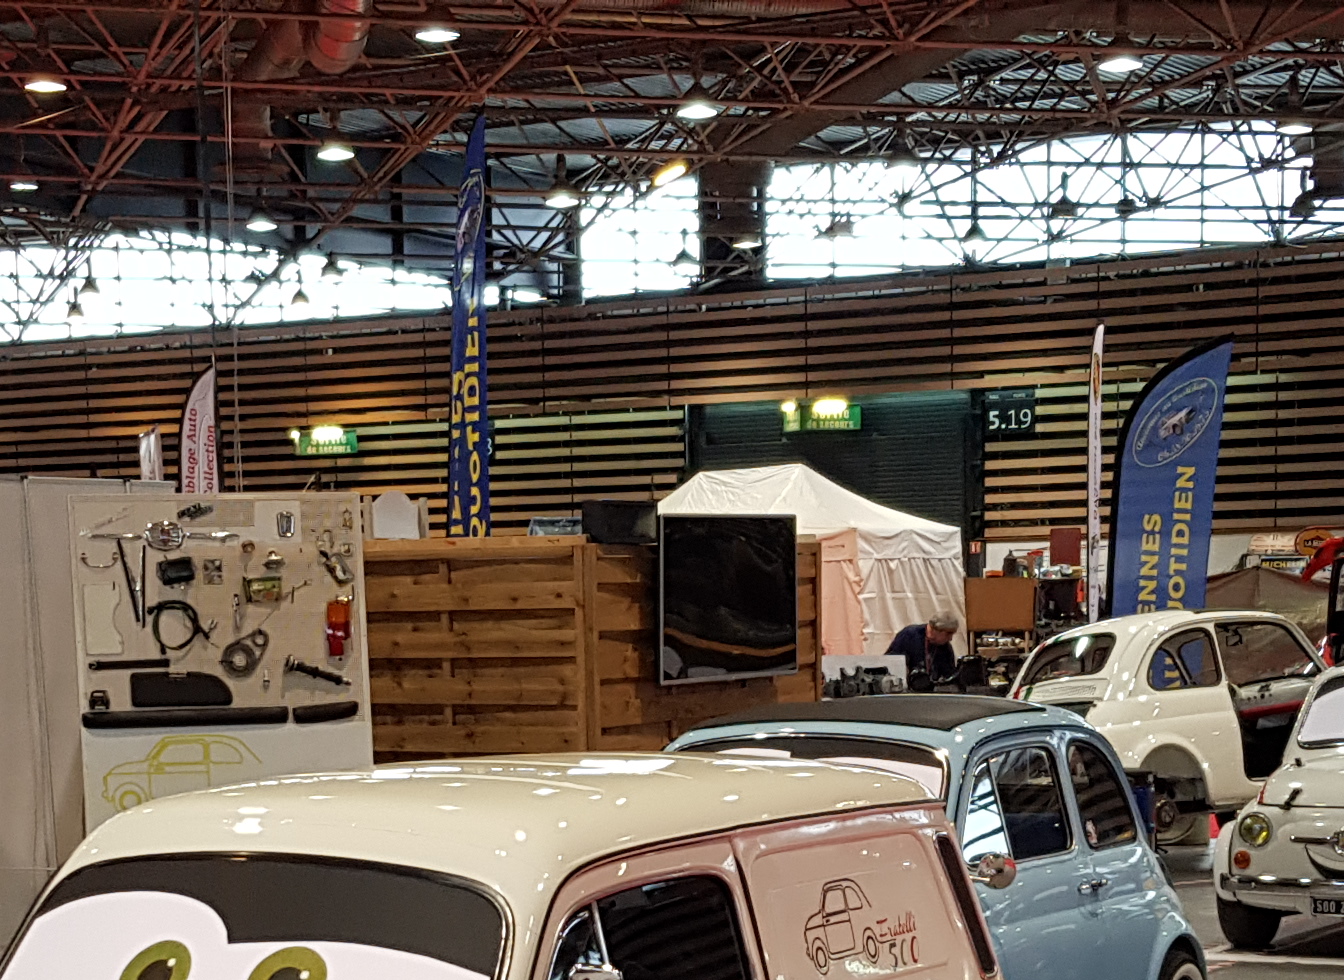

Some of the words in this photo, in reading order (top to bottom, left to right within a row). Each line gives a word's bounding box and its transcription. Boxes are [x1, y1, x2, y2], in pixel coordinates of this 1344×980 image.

[187, 408, 198, 444] Auto
[989, 409, 1032, 430] 5.19
[185, 448, 198, 493] blage
[203, 425, 215, 493] ollection
[1316, 900, 1336, 912] 500
